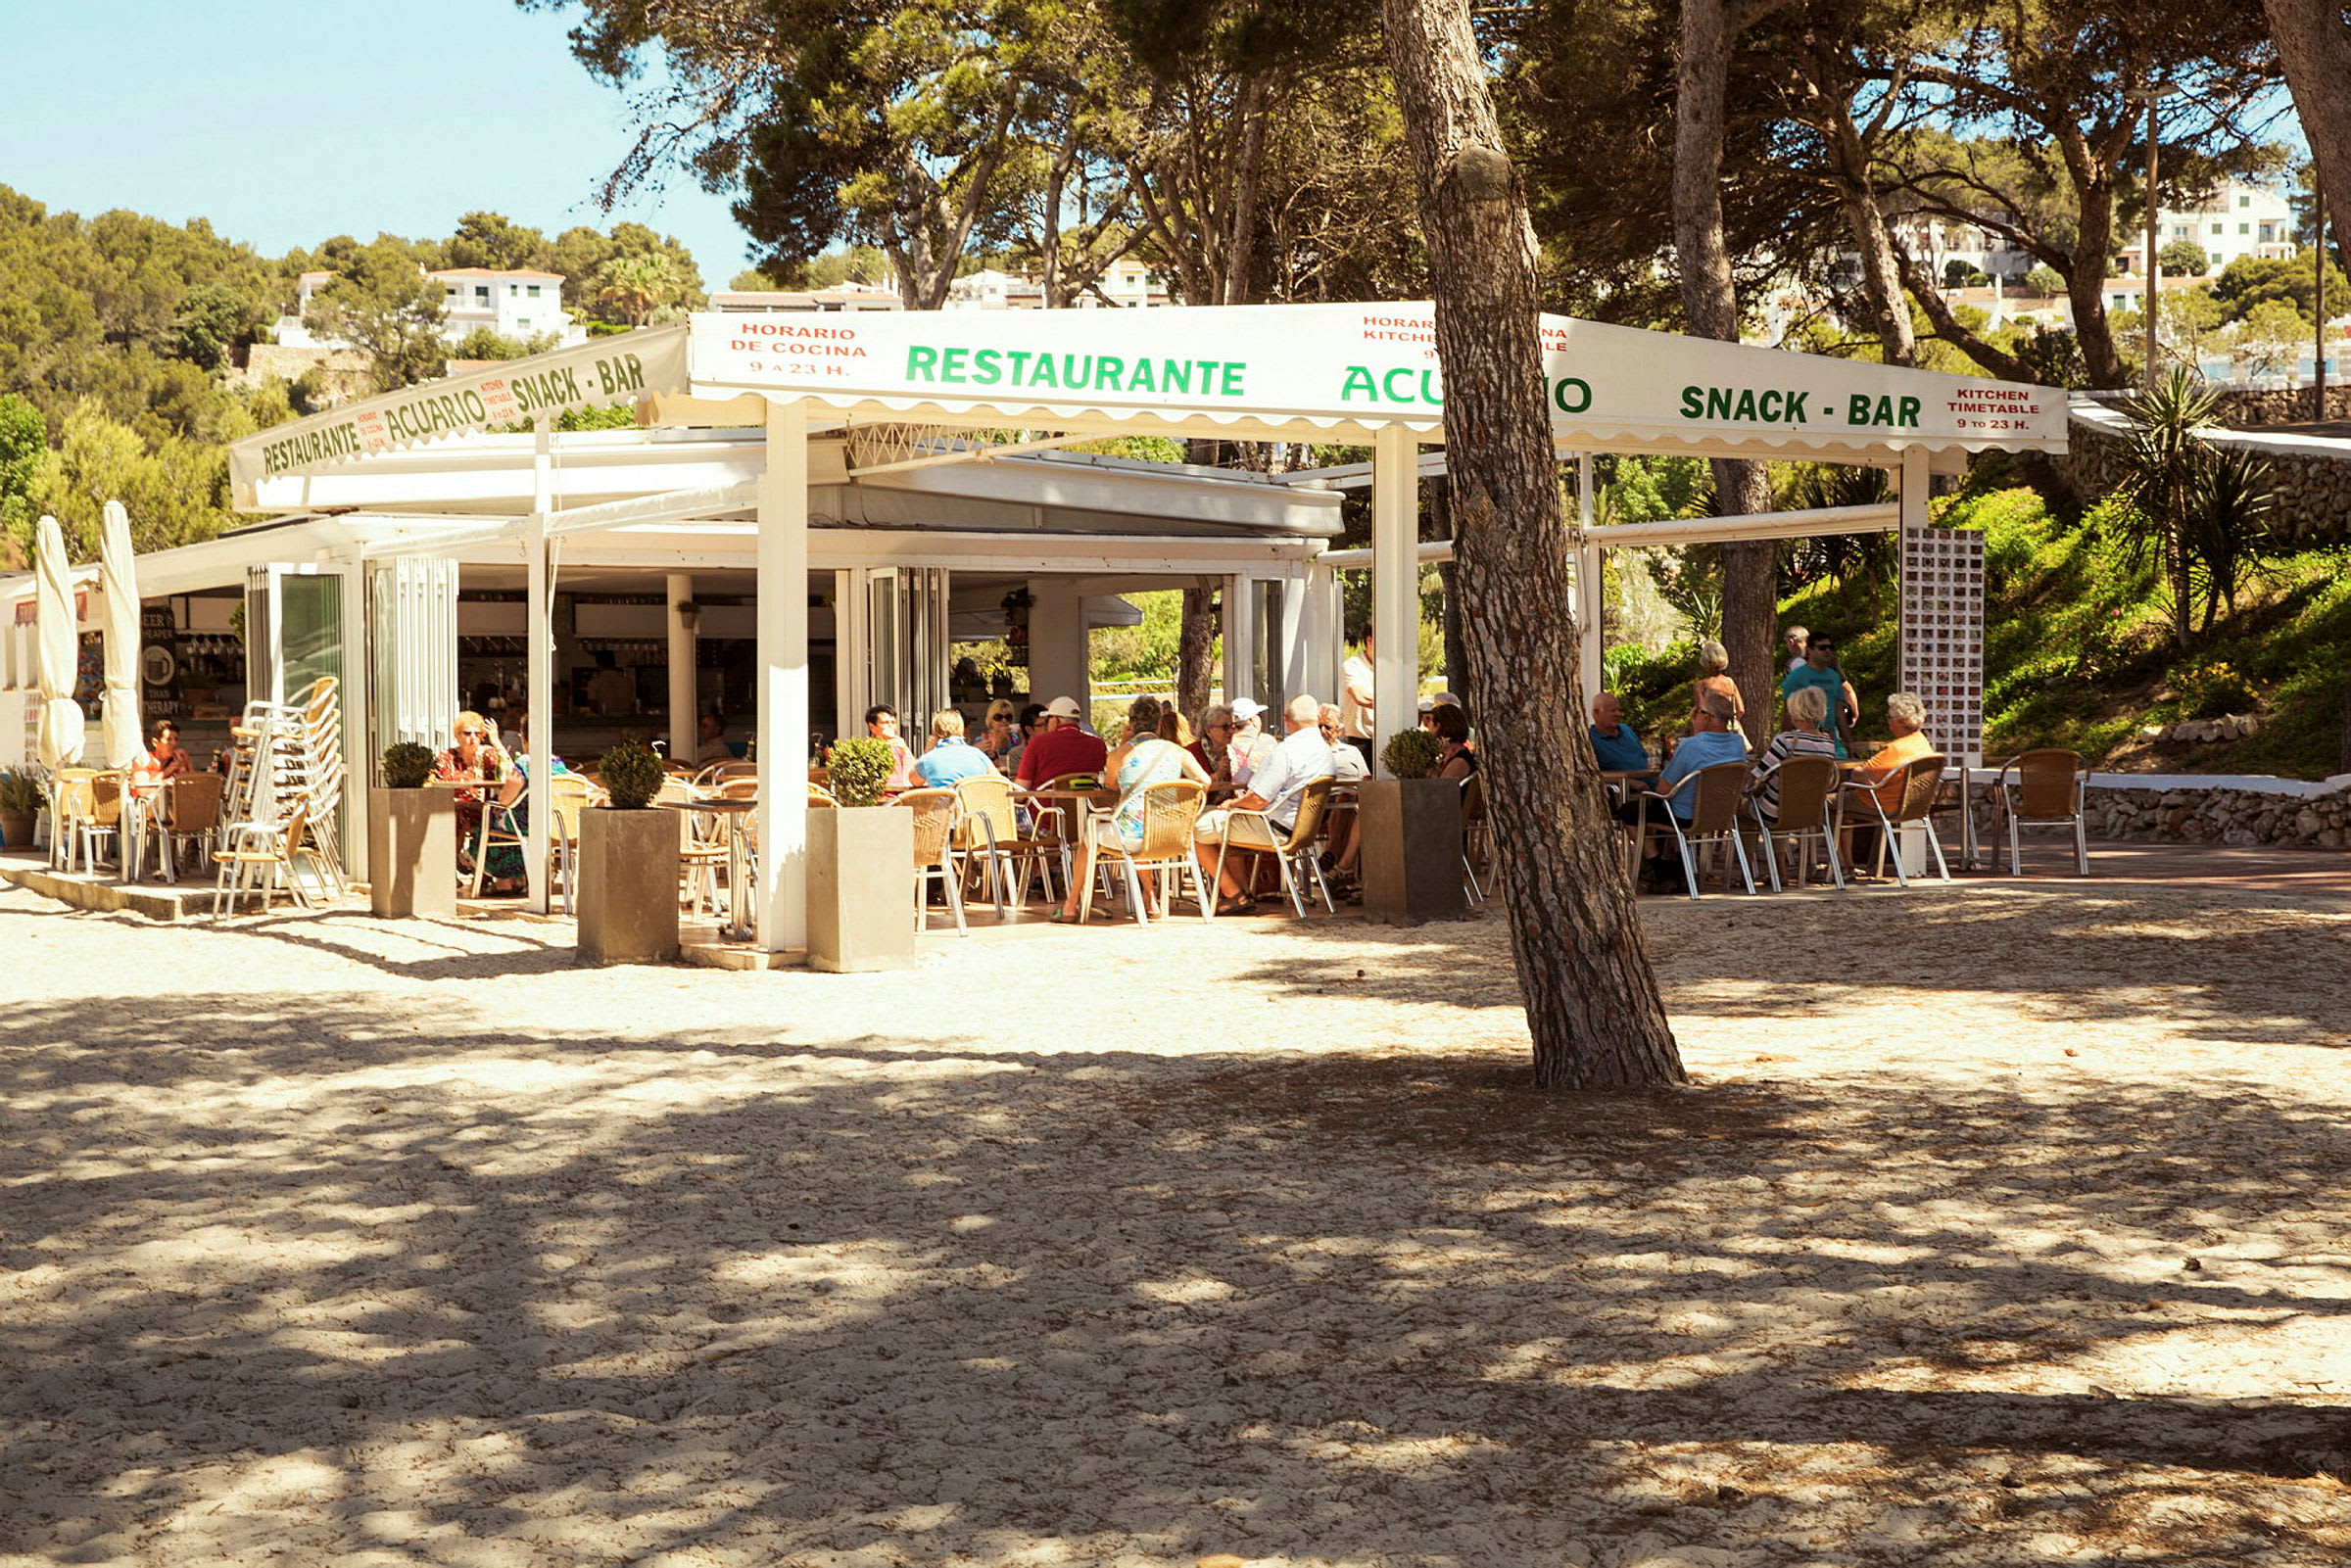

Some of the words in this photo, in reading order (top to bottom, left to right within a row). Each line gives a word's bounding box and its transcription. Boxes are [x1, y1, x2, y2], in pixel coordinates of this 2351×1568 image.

[1363, 315, 1437, 330] HORAR
[742, 323, 855, 340] HORARIO
[1363, 330, 1437, 344] KITCHE
[731, 340, 763, 352] DE
[771, 342, 867, 357] COCINA
[749, 360, 763, 372] 9
[790, 362, 817, 375] 23
[827, 365, 851, 377] H.
[905, 345, 1247, 397] RESTAURANTE
[511, 366, 582, 412] SNACK
[596, 353, 645, 396] BAR
[1341, 365, 1593, 413] ACUO
[1957, 389, 2029, 402] KITCHEN
[1679, 386, 1809, 424] SNACK
[1847, 394, 1922, 428] BAR
[1947, 403, 2040, 414] TIMETABLE
[384, 390, 486, 442] ACUARIO
[1957, 418, 1967, 428] 9
[1991, 419, 2010, 429] 23
[2014, 420, 2030, 430] H.
[263, 422, 360, 475] RESTAURANTE
